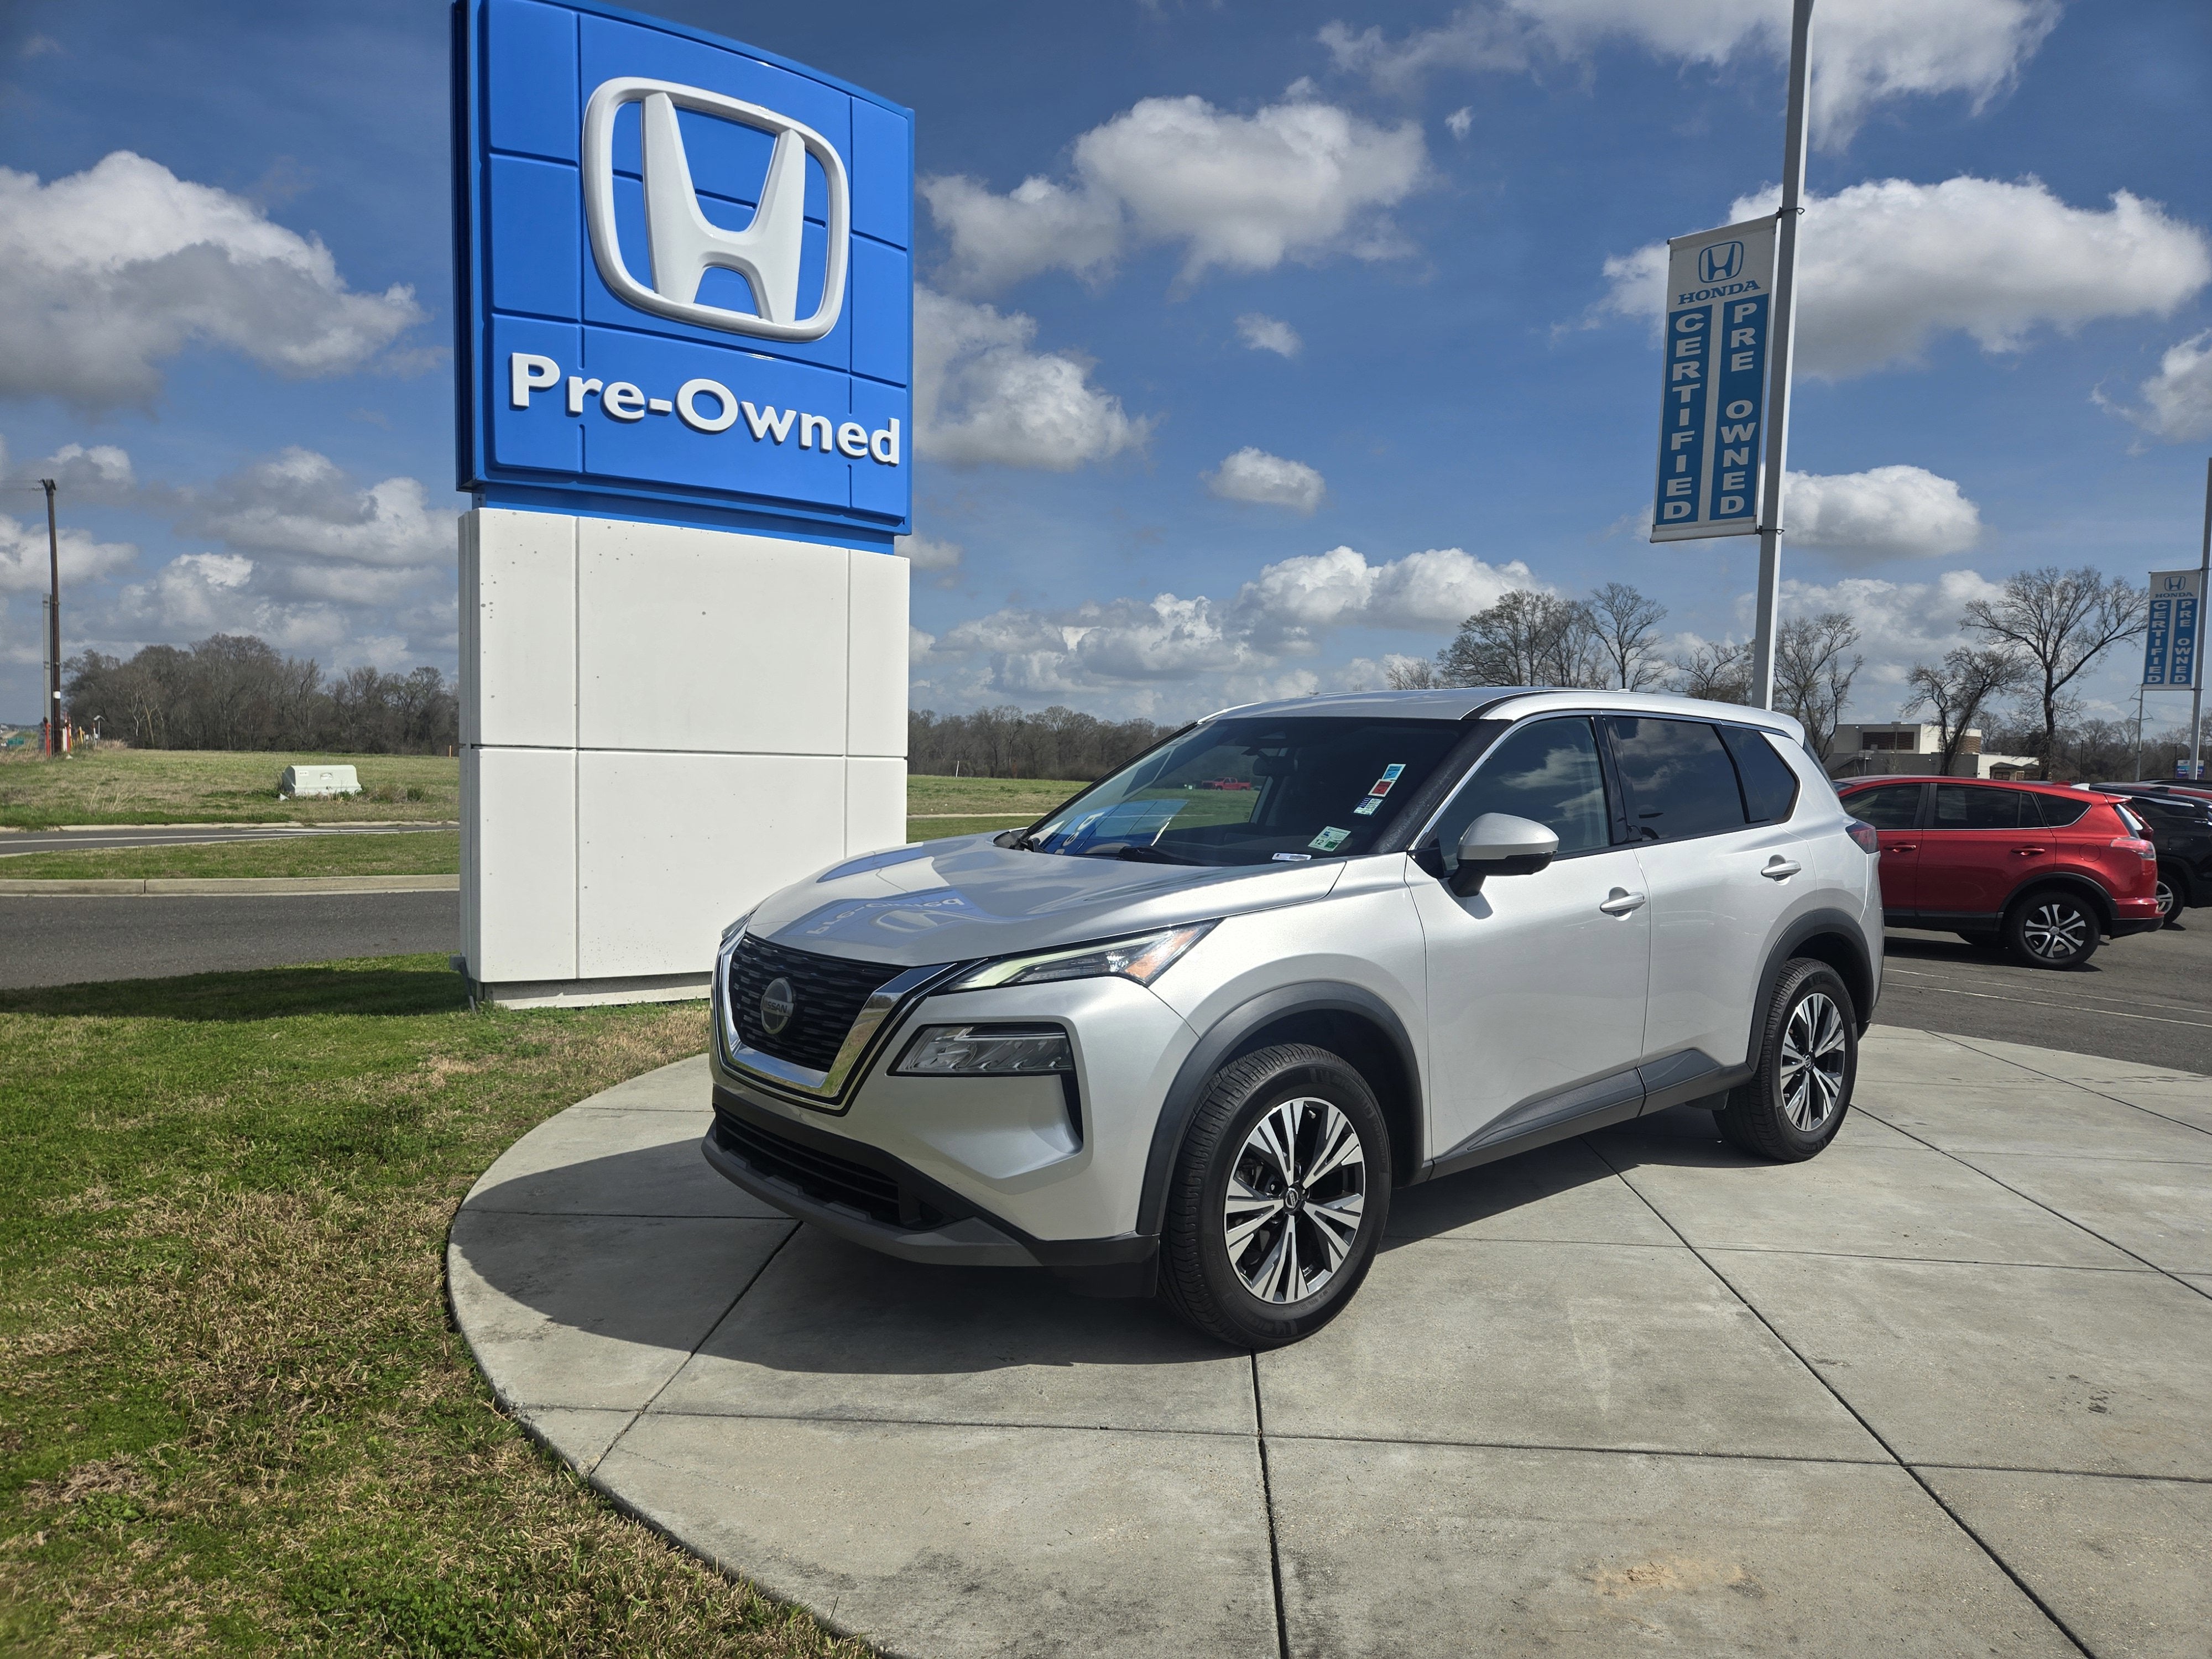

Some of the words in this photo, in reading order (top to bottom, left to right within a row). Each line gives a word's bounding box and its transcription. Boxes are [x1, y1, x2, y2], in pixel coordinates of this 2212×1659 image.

[1678, 280, 1761, 305] HONDA
[1730, 302, 1757, 372] PRE
[510, 352, 901, 466] Pre-Owned
[1663, 313, 1705, 519] CERTIFIED
[1720, 399, 1757, 515] OWNED
[2147, 602, 2168, 683] CERTIFIED
[2180, 601, 2193, 627] PRE
[2174, 638, 2192, 682] OWNED
